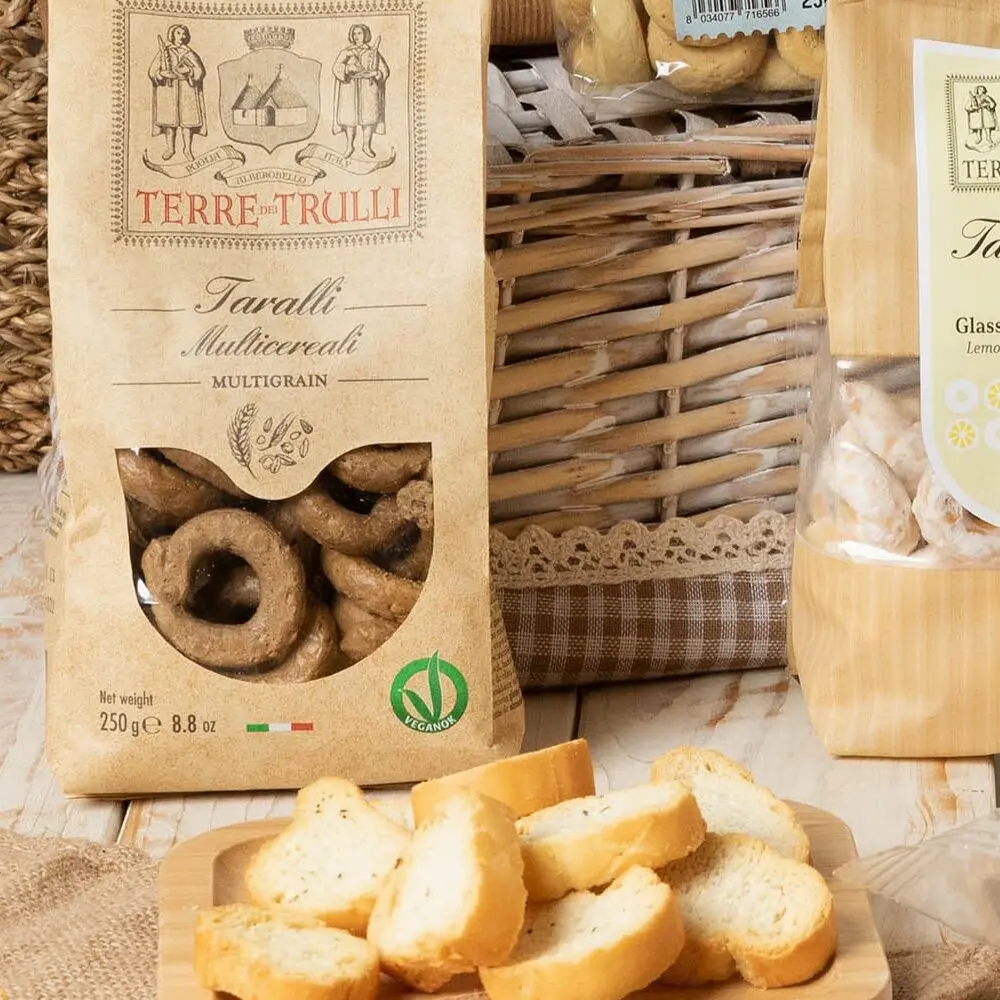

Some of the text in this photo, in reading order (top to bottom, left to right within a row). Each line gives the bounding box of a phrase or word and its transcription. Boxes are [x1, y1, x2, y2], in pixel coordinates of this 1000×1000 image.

[685, 8, 780, 25] 8 034077 716566
[135, 188, 259, 228] TERRE
[273, 185, 401, 226] TRULLI
[194, 275, 345, 317] Taralli
[180, 322, 365, 357] Multicereali
[211, 373, 328, 390] MULTIGRAIN
[99, 689, 153, 709] Net weight
[100, 711, 216, 734] 250 8.8 oz
[404, 714, 457, 732] VEGANOK
